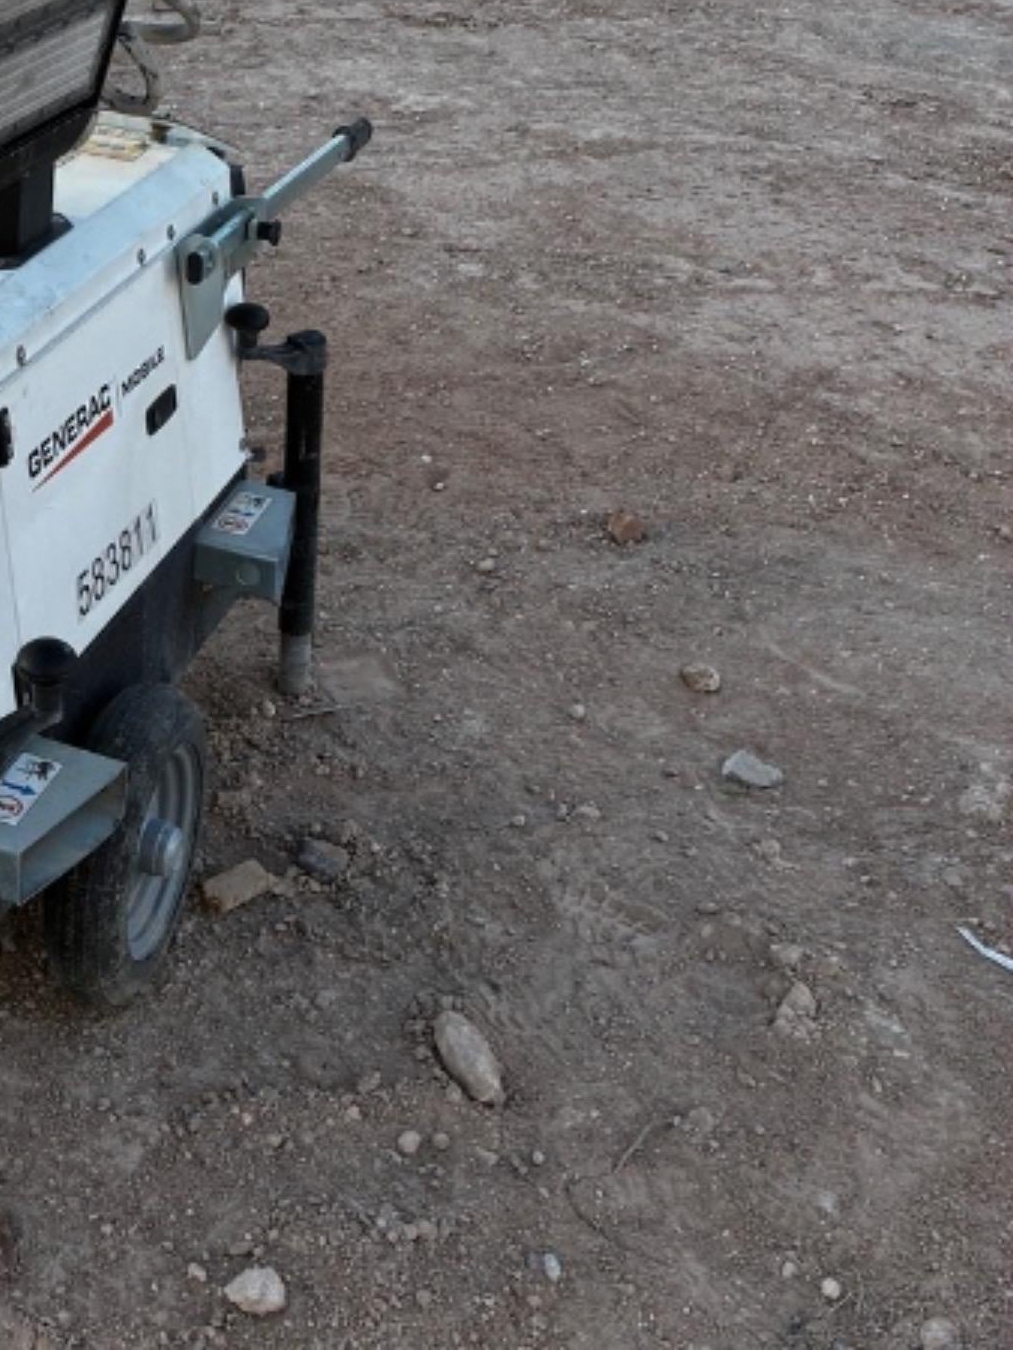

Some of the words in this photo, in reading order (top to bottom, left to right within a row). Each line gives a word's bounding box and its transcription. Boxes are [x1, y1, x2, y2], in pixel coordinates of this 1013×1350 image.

[27, 384, 112, 478] GENERAC
[120, 345, 165, 397] MOBILE
[76, 502, 158, 616] 583811
